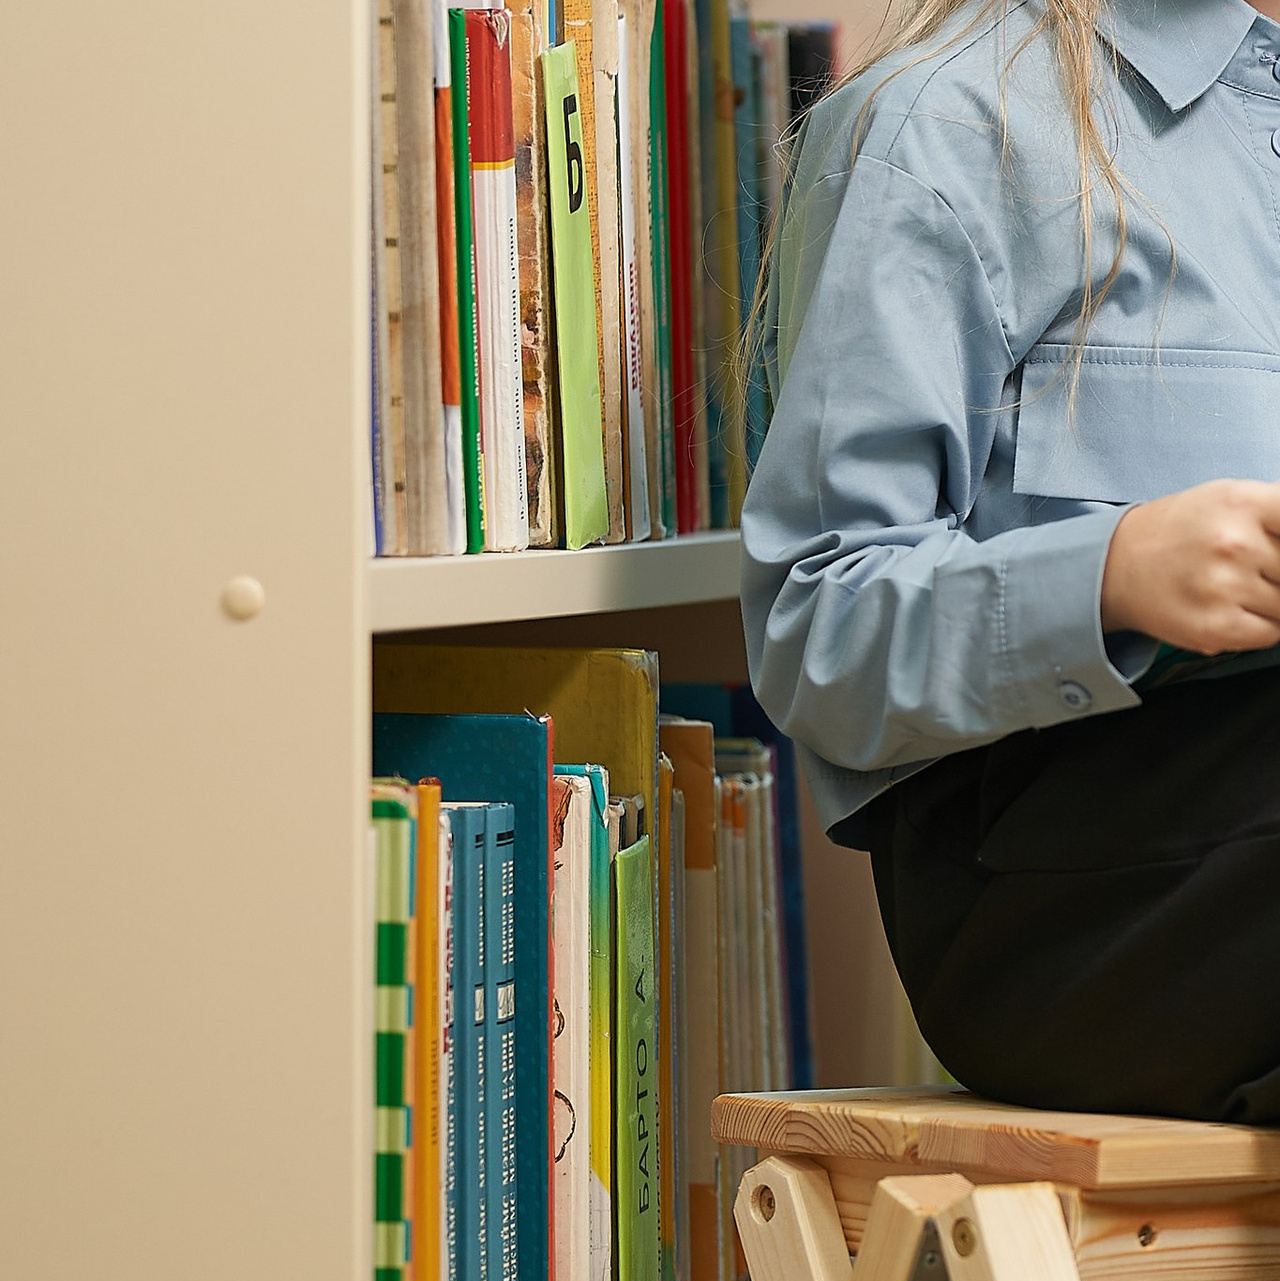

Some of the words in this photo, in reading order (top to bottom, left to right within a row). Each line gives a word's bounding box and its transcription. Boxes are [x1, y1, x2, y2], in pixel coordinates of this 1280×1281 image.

[562, 93, 586, 215] Б
[629, 261, 639, 391] шкатулка
[634, 955, 646, 1004] А.
[501, 1033, 509, 1100] БАРРИ
[635, 1039, 650, 1214] БАРТО
